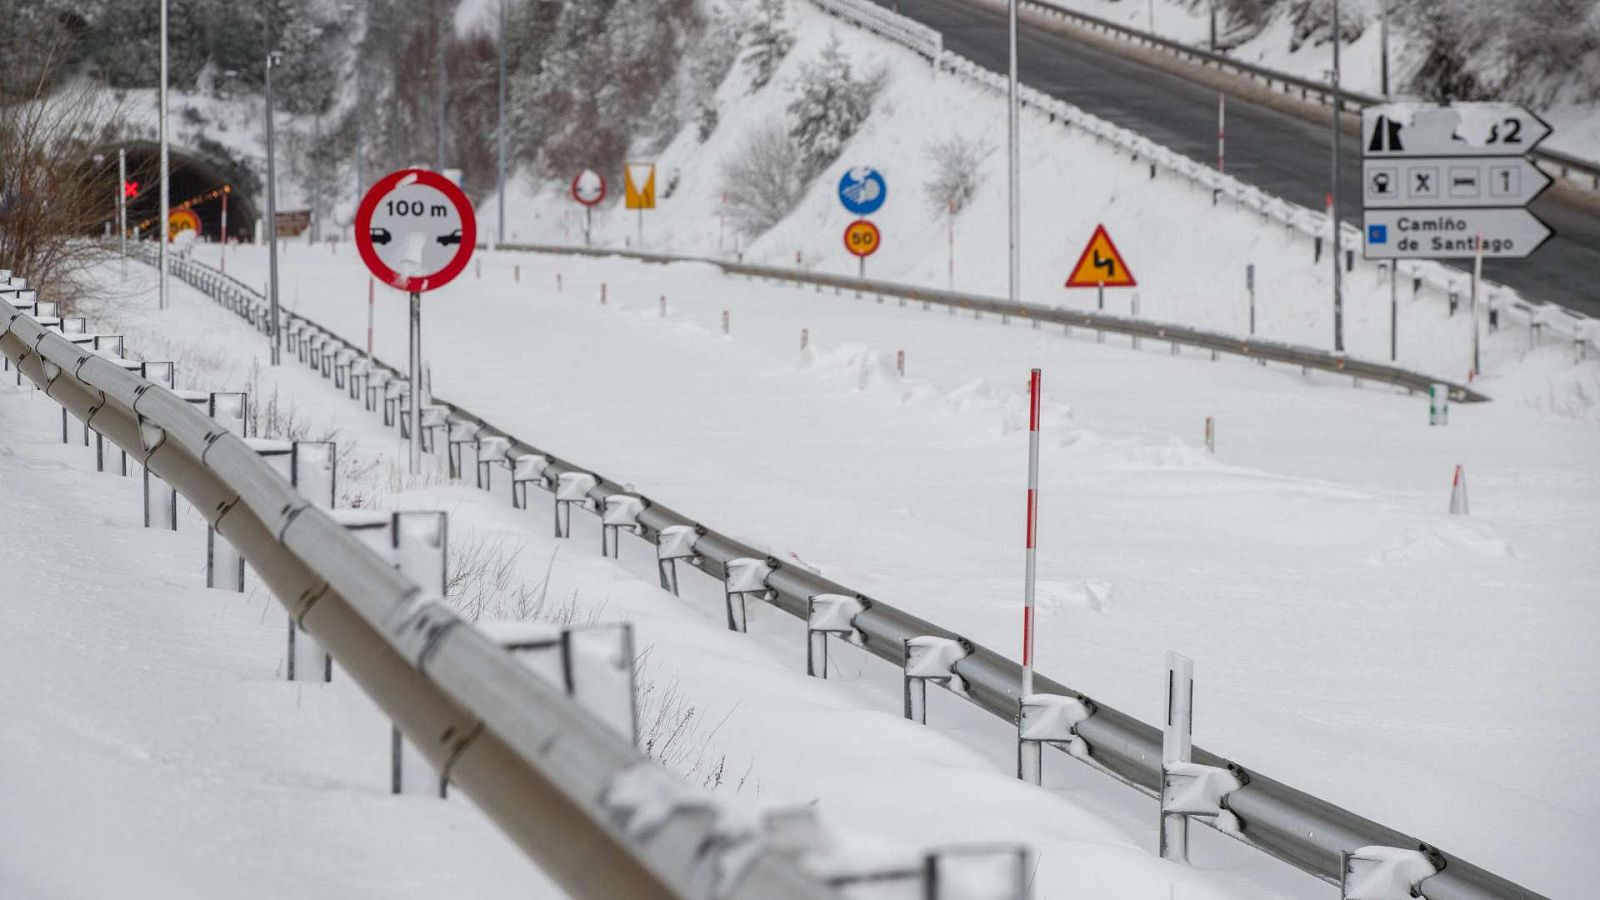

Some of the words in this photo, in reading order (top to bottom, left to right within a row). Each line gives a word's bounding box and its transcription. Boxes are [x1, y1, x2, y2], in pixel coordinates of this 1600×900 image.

[386, 200, 424, 216] 100
[430, 204, 447, 217] m
[852, 231, 874, 245] 50
[1397, 236, 1419, 251] de
[1431, 236, 1514, 254] Santiago
